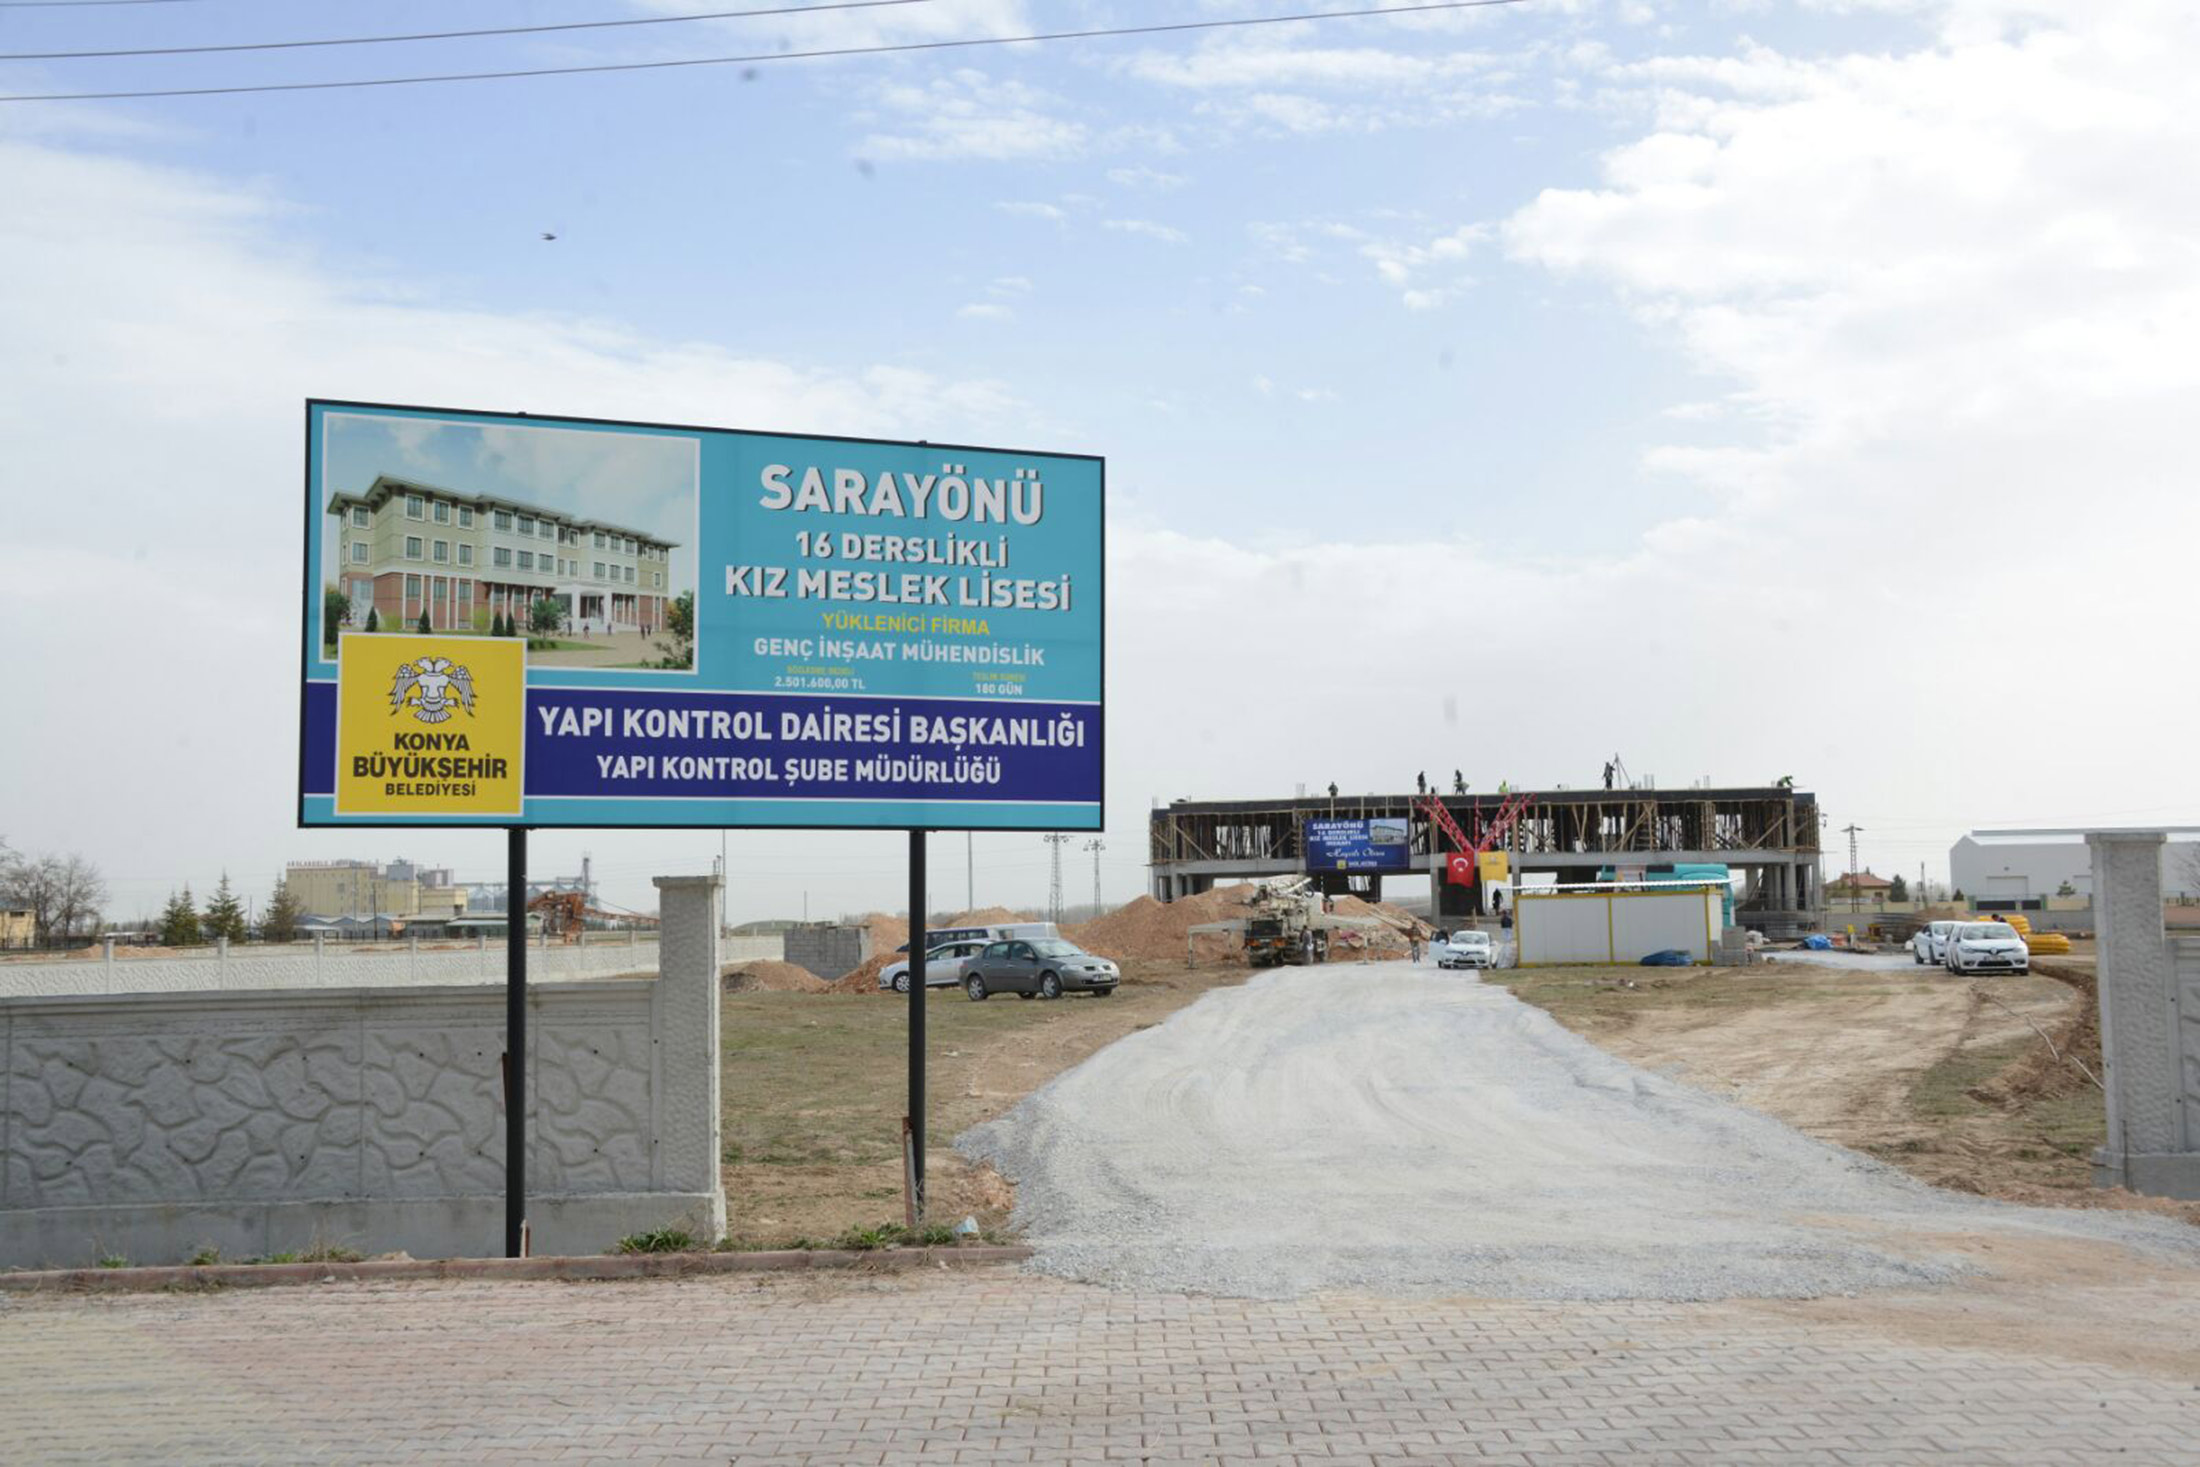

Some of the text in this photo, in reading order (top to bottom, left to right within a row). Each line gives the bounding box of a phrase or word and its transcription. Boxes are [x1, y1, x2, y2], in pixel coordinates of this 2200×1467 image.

[760, 463, 1042, 525] SARAYÖNÜ
[797, 531, 1007, 567] 16 DERSLİKLİ
[726, 566, 1069, 610] KIZ MESLEK LİSESİ
[822, 613, 990, 635] YÜKLENİCİ FİRMA
[754, 635, 1045, 666] GENÇ İNŞAAT MÜHENDİSLİK
[774, 676, 867, 690] 2.501.600,00 TL
[998, 682, 1023, 696] GÜN
[394, 733, 470, 752] KONYA
[539, 706, 1084, 751] YAPI KONTROL DAİRESİ BAŞKANLIĞI
[353, 751, 508, 782] BÜYÜKŞEHİR
[597, 754, 1001, 787] YAPI KONTROL ŞUBE MÜDÜRLÜĞÜ
[385, 779, 476, 797] BELEDİYESİ
